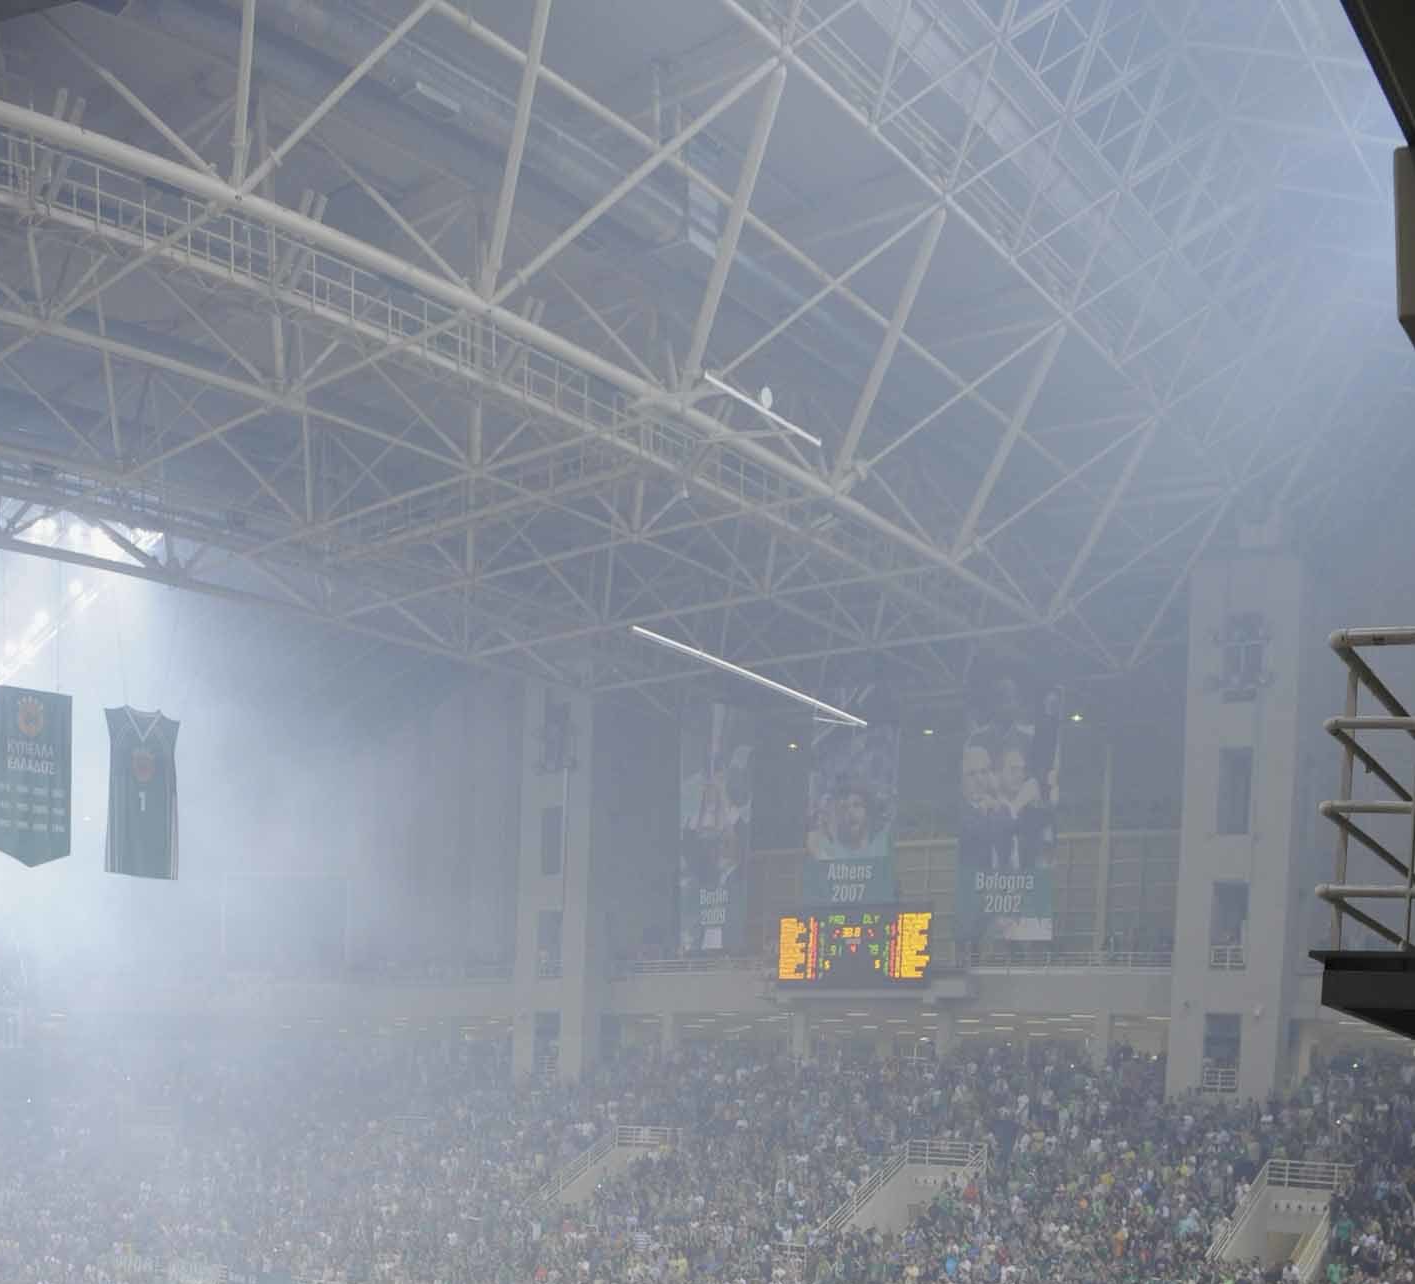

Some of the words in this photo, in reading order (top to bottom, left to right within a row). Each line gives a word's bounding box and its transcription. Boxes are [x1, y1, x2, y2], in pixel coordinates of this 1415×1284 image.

[827, 863, 873, 881] Athens
[831, 884, 865, 902] 2007
[975, 872, 1034, 896] Bologna
[699, 887, 728, 906] Berlin
[985, 895, 1020, 914] 2002
